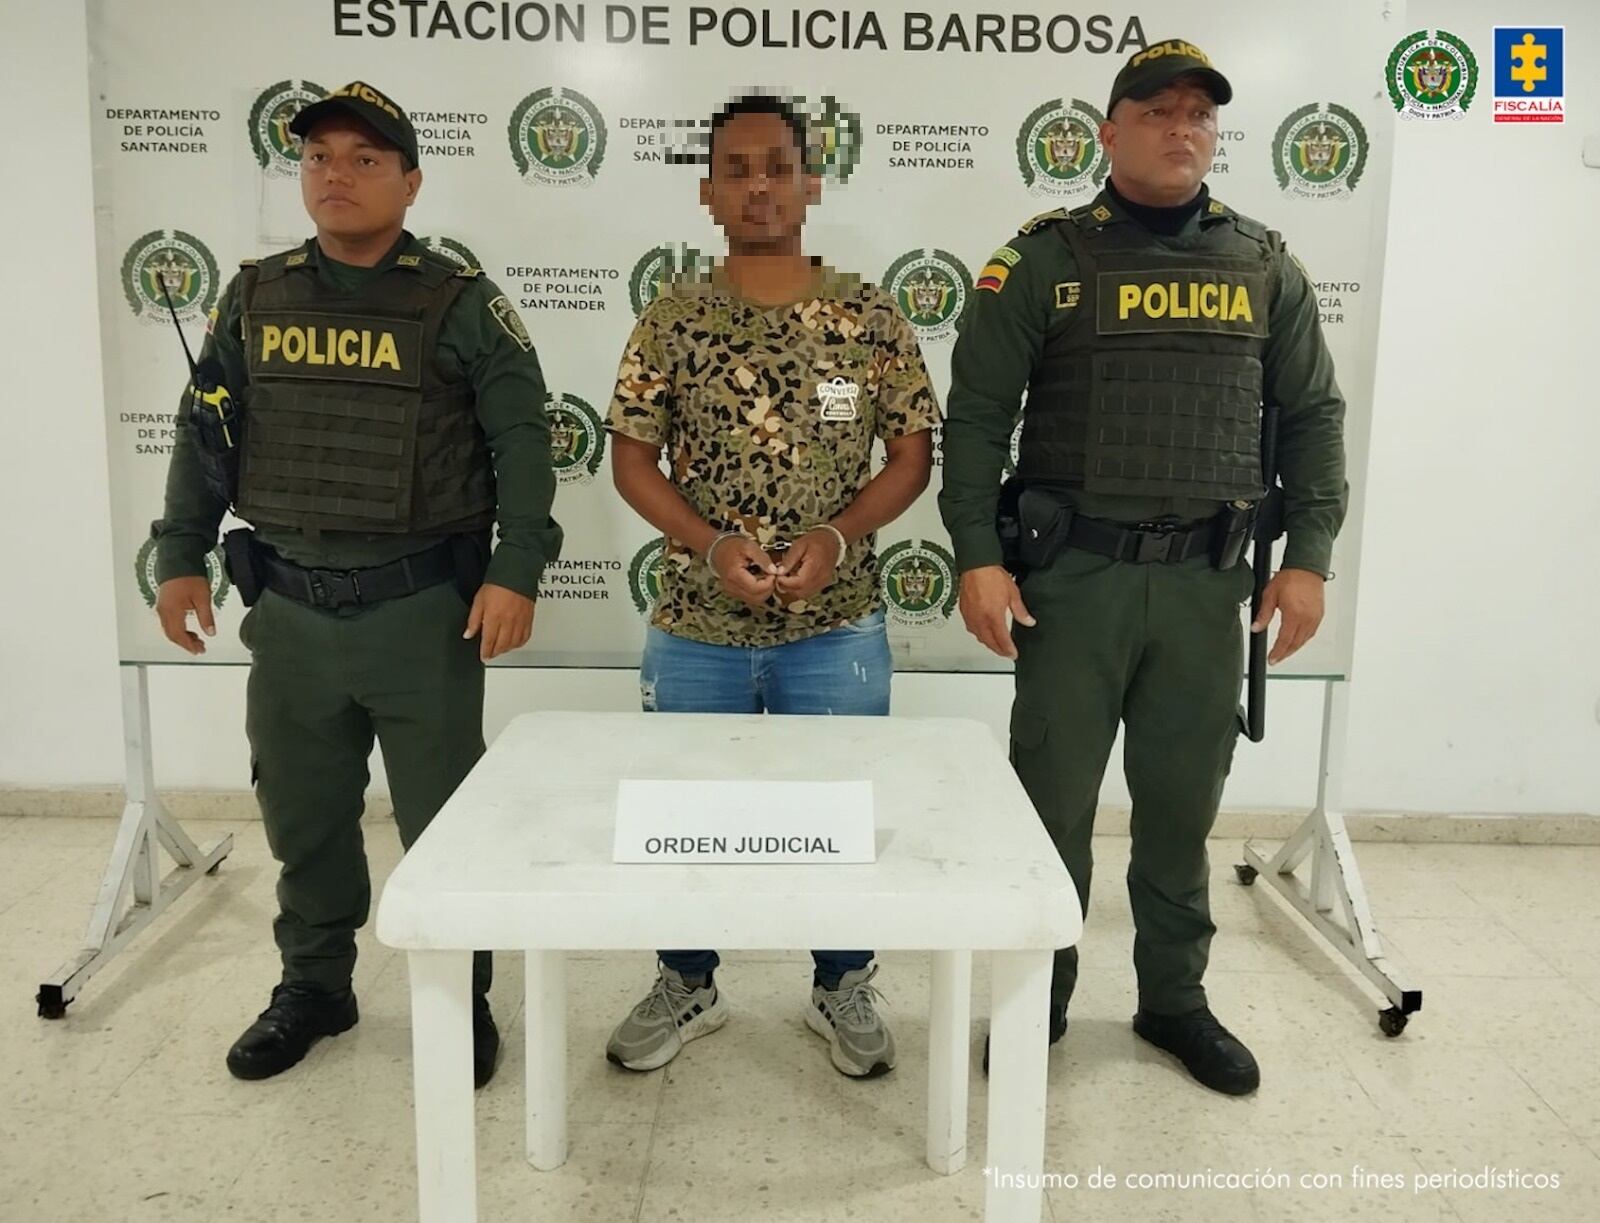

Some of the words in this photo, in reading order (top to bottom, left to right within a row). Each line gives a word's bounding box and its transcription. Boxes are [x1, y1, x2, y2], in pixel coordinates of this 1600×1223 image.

[333, 0, 584, 42] ESTACION
[606, 5, 670, 45] DE
[690, 7, 888, 50] POLICIA
[904, 12, 1148, 53] BARBOSA
[106, 109, 220, 123] DEPARTAMENTO
[410, 112, 487, 124] RTAMENTO
[124, 125, 142, 136] DE
[147, 123, 203, 137] POLICÍA
[876, 124, 989, 137] DEPARTAMENTO
[637, 135, 655, 146] DE
[893, 141, 910, 151] DE
[915, 139, 971, 152] POLICÍA
[121, 142, 207, 154] SANTANDER
[418, 145, 475, 157] TANDER
[889, 157, 974, 168] SANTANDER
[506, 267, 619, 280] DEPARTAMENTO
[524, 283, 541, 293] DE
[546, 282, 602, 294] POLICÍA
[520, 299, 605, 312] SANTANDER
[1119, 282, 1253, 322] POLICIA
[262, 325, 401, 370] POLICIA
[138, 429, 155, 439] DE
[548, 561, 621, 570] RTAMENTO
[551, 573, 605, 585] POLICÍA
[538, 590, 608, 600] ANTANDER
[645, 837, 726, 854] ORDEN
[734, 837, 840, 854] JUDICIAL
